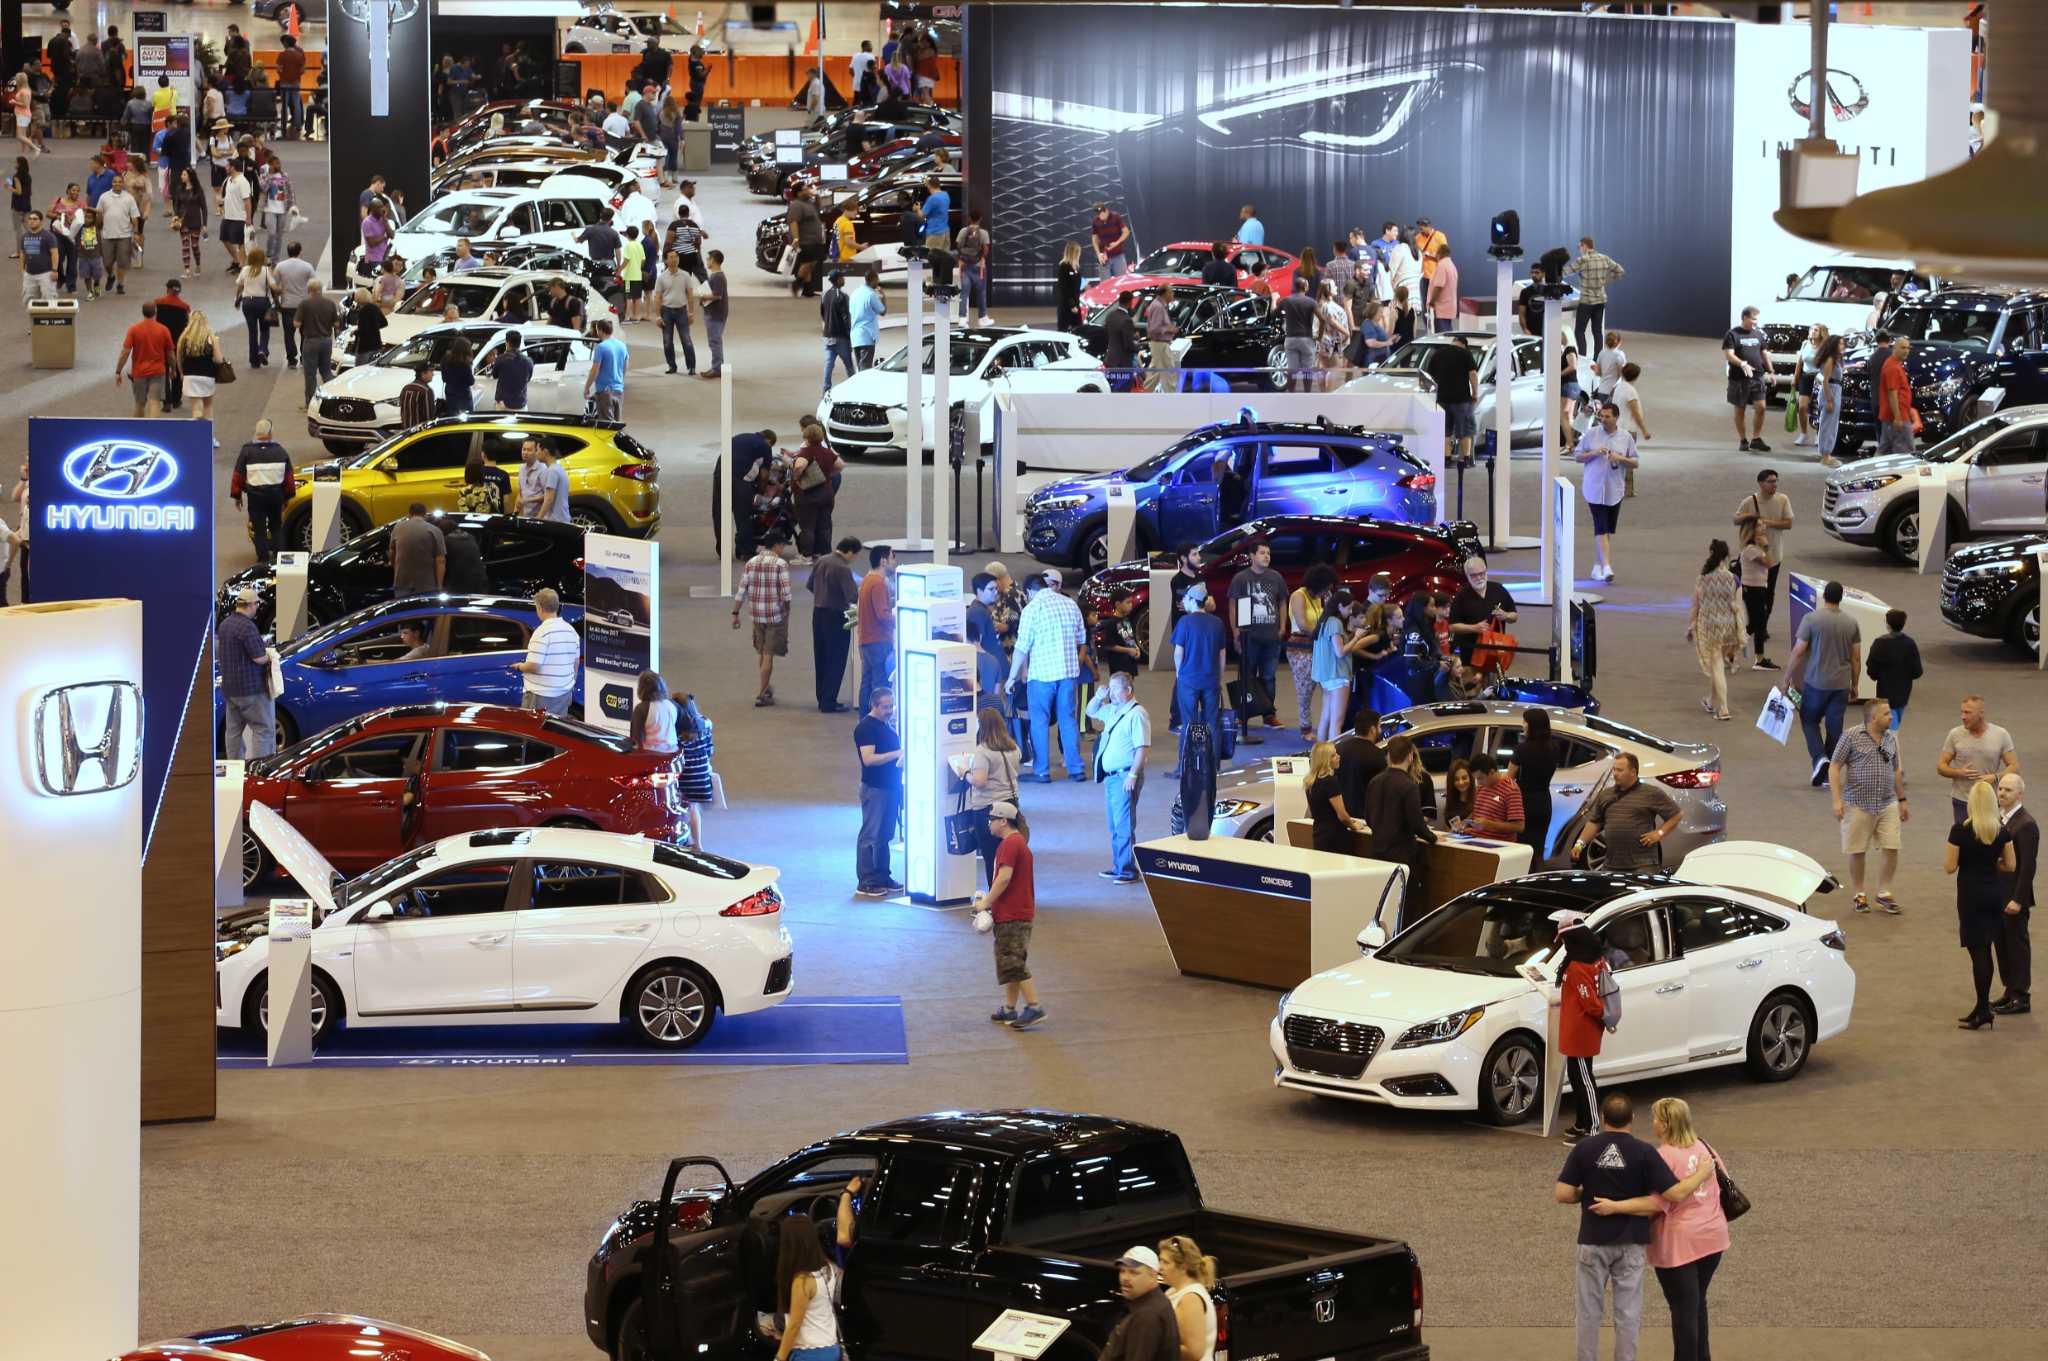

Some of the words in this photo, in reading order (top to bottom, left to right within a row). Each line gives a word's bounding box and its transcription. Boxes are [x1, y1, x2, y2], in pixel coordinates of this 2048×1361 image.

[932, 5, 962, 17] GM
[1762, 140, 1896, 166] INITI
[47, 504, 195, 530] HYUNDAI
[1167, 860, 1200, 873] HYUNDAI
[1261, 875, 1294, 888] CONCIERGE
